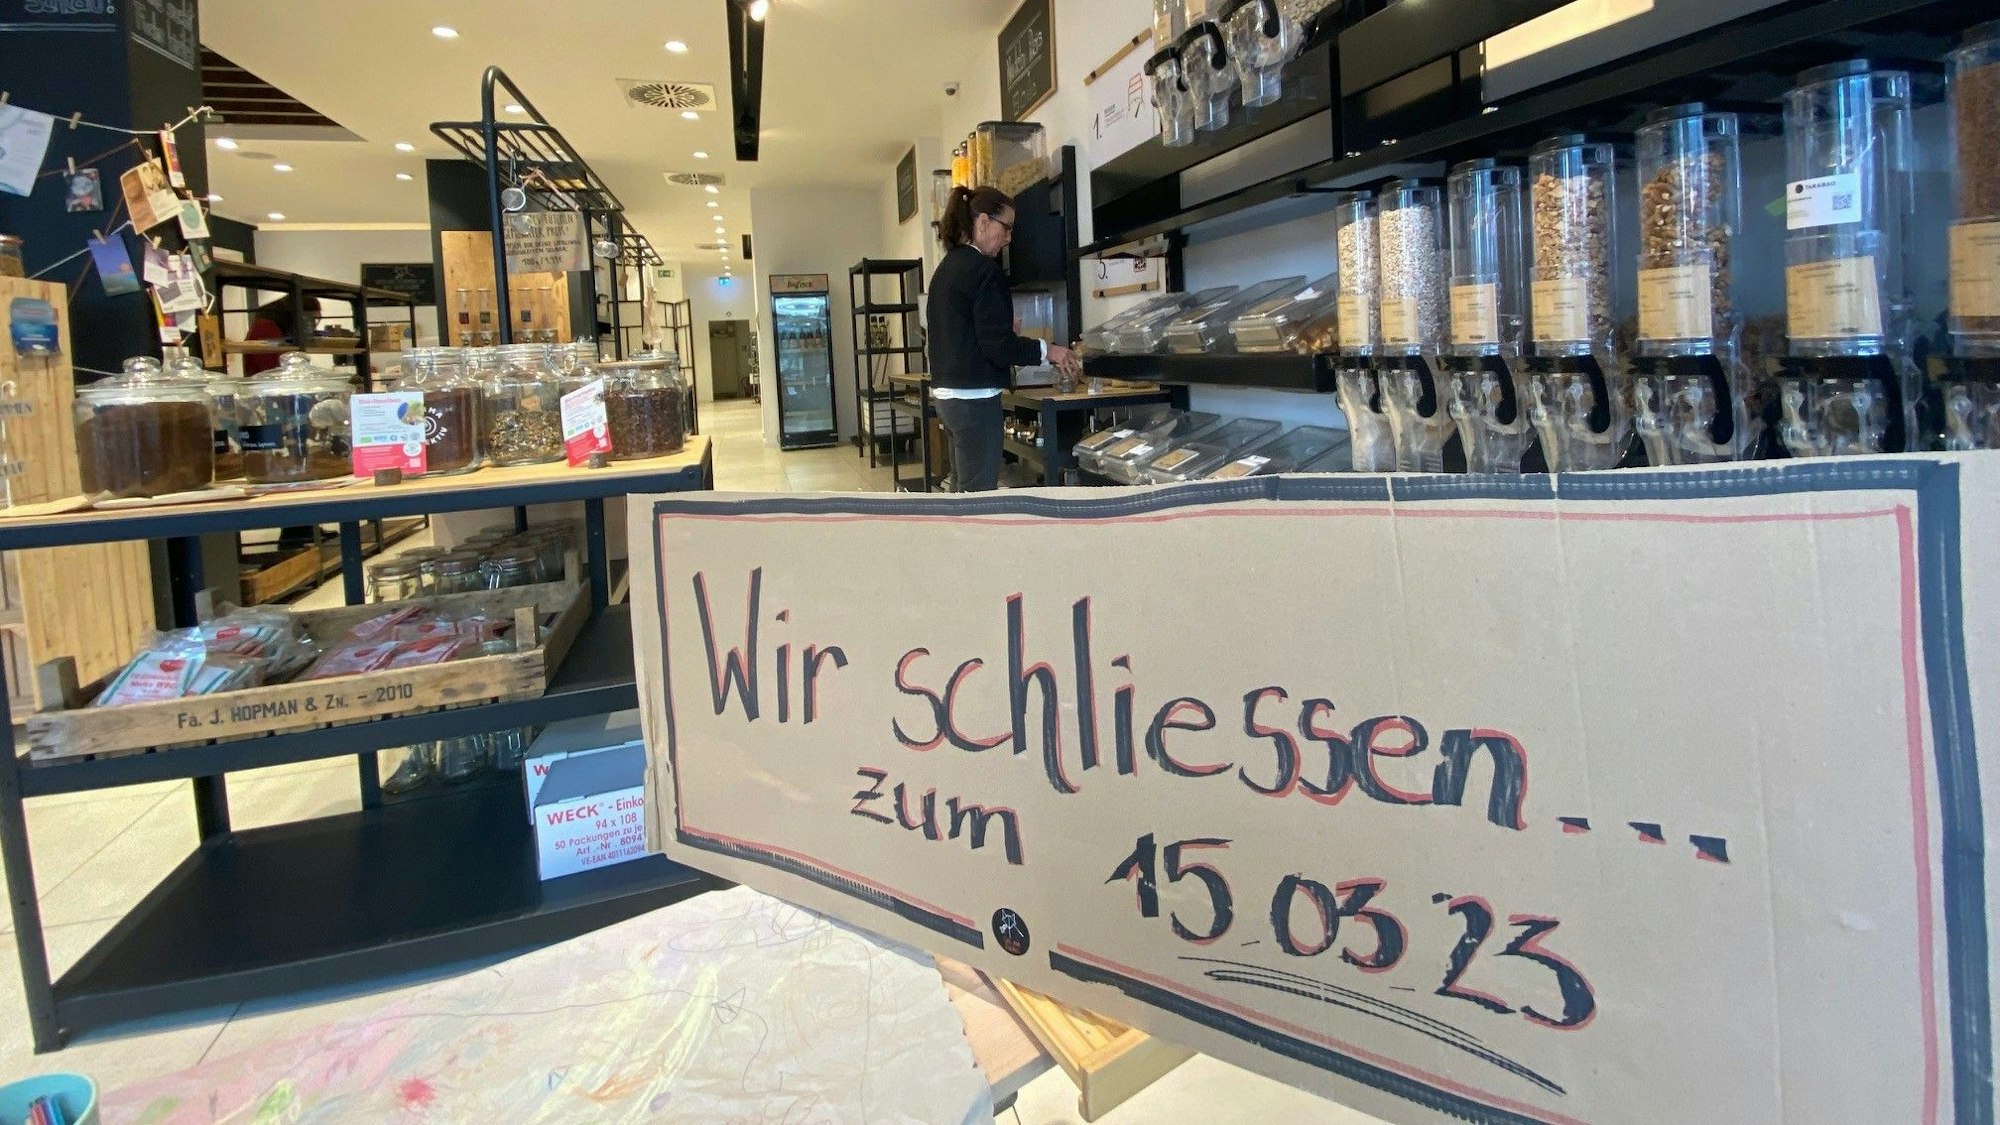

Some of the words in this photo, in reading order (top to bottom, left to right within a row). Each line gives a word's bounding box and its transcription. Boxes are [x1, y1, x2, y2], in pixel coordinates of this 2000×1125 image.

[692, 567, 848, 725] Wir
[176, 713, 203, 729] Fa.
[209, 709, 225, 725] J.
[230, 699, 299, 723] HOPMAN
[304, 697, 318, 712] &
[376, 683, 413, 703] 2010
[595, 818, 608, 830] 94
[610, 819, 617, 828] x
[620, 812, 637, 825] 108
[850, 766, 1025, 866] zum
[555, 840, 566, 851] 50
[569, 829, 620, 847] Packungen
[623, 827, 632, 836] zu
[634, 823, 643, 834] je
[620, 833, 643, 847] 8094
